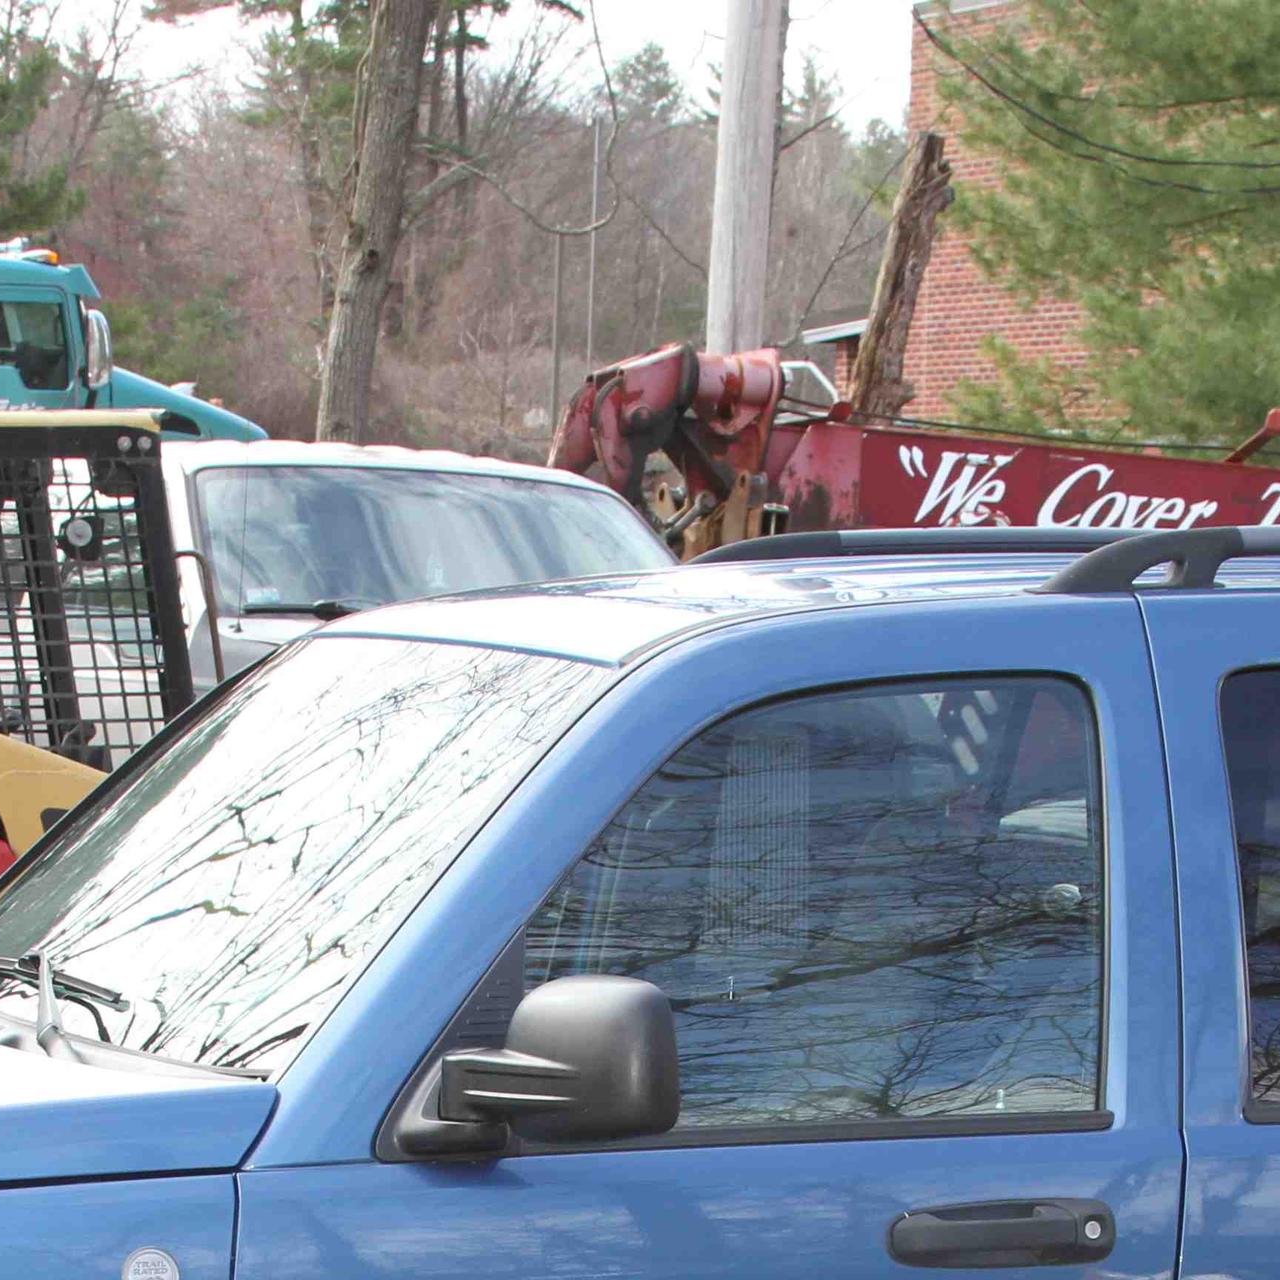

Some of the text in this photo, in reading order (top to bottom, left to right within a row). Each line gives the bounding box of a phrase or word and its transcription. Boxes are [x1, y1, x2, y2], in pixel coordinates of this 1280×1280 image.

[1036, 463, 1218, 531] Cover
[134, 1260, 168, 1269] TRAIL
[133, 1267, 169, 1276] RATED
